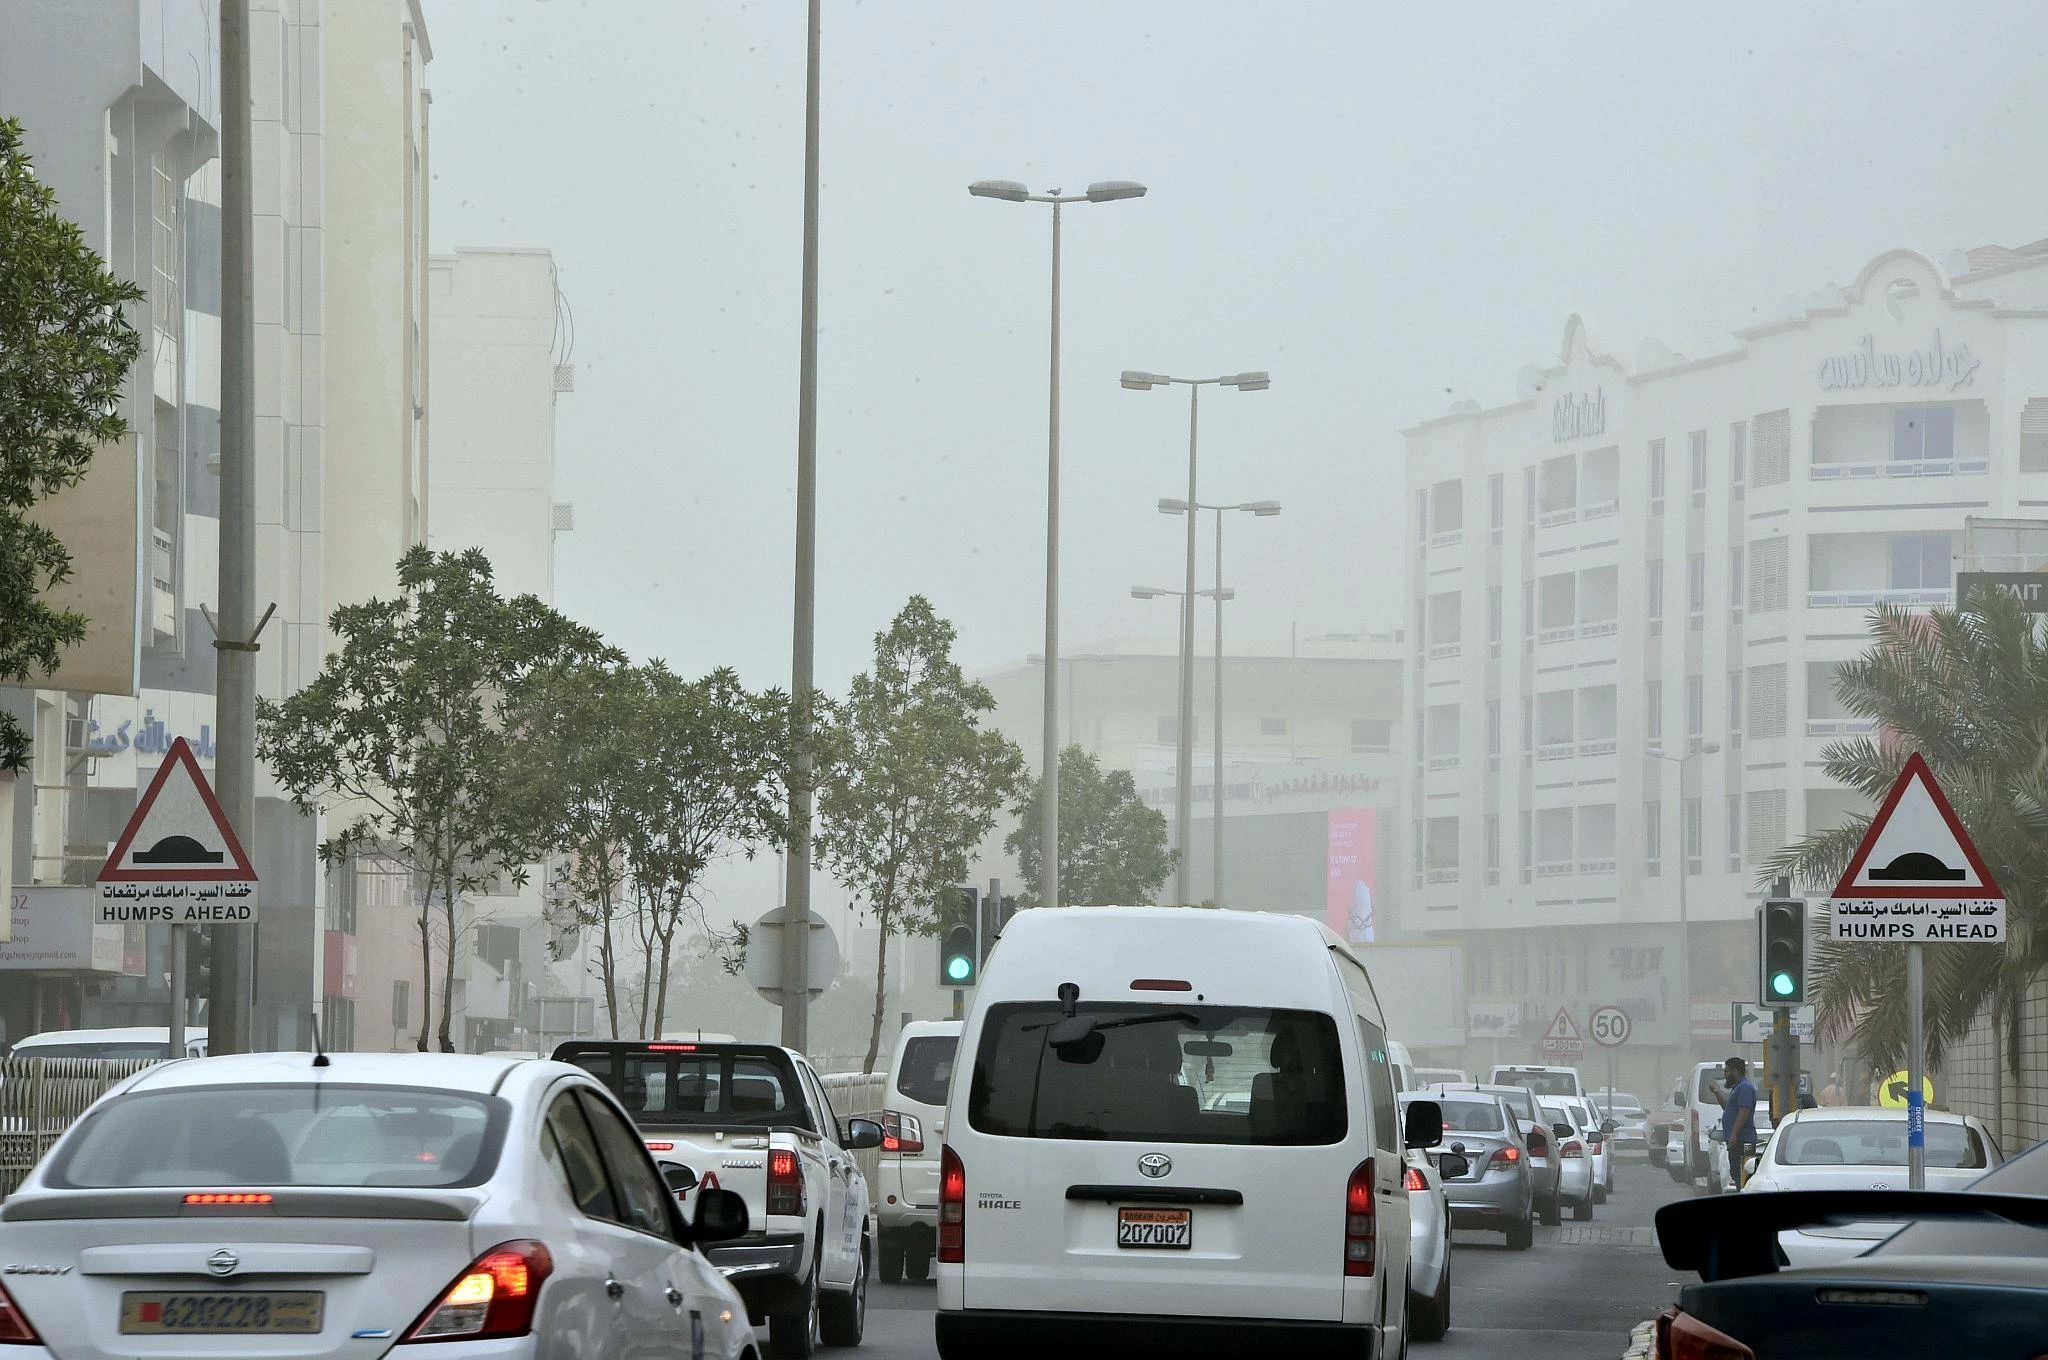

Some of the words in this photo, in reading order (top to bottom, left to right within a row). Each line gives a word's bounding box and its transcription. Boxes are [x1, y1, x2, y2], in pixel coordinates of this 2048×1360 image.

[103, 884, 150, 901] مرتفعات
[225, 884, 252, 898] خفف
[103, 906, 174, 921] HUMPS
[184, 906, 251, 920] AHEAD
[1838, 901, 1888, 918] مرتفعات
[1969, 901, 1998, 915] خفف
[1839, 923, 1914, 938] HUMPS
[1926, 924, 1998, 938] AHEAD
[1596, 1015, 1625, 1038] 50
[1555, 1041, 1568, 1050] 200
[978, 1200, 1021, 1209] HIACE
[1120, 1223, 1187, 1244] 207007
